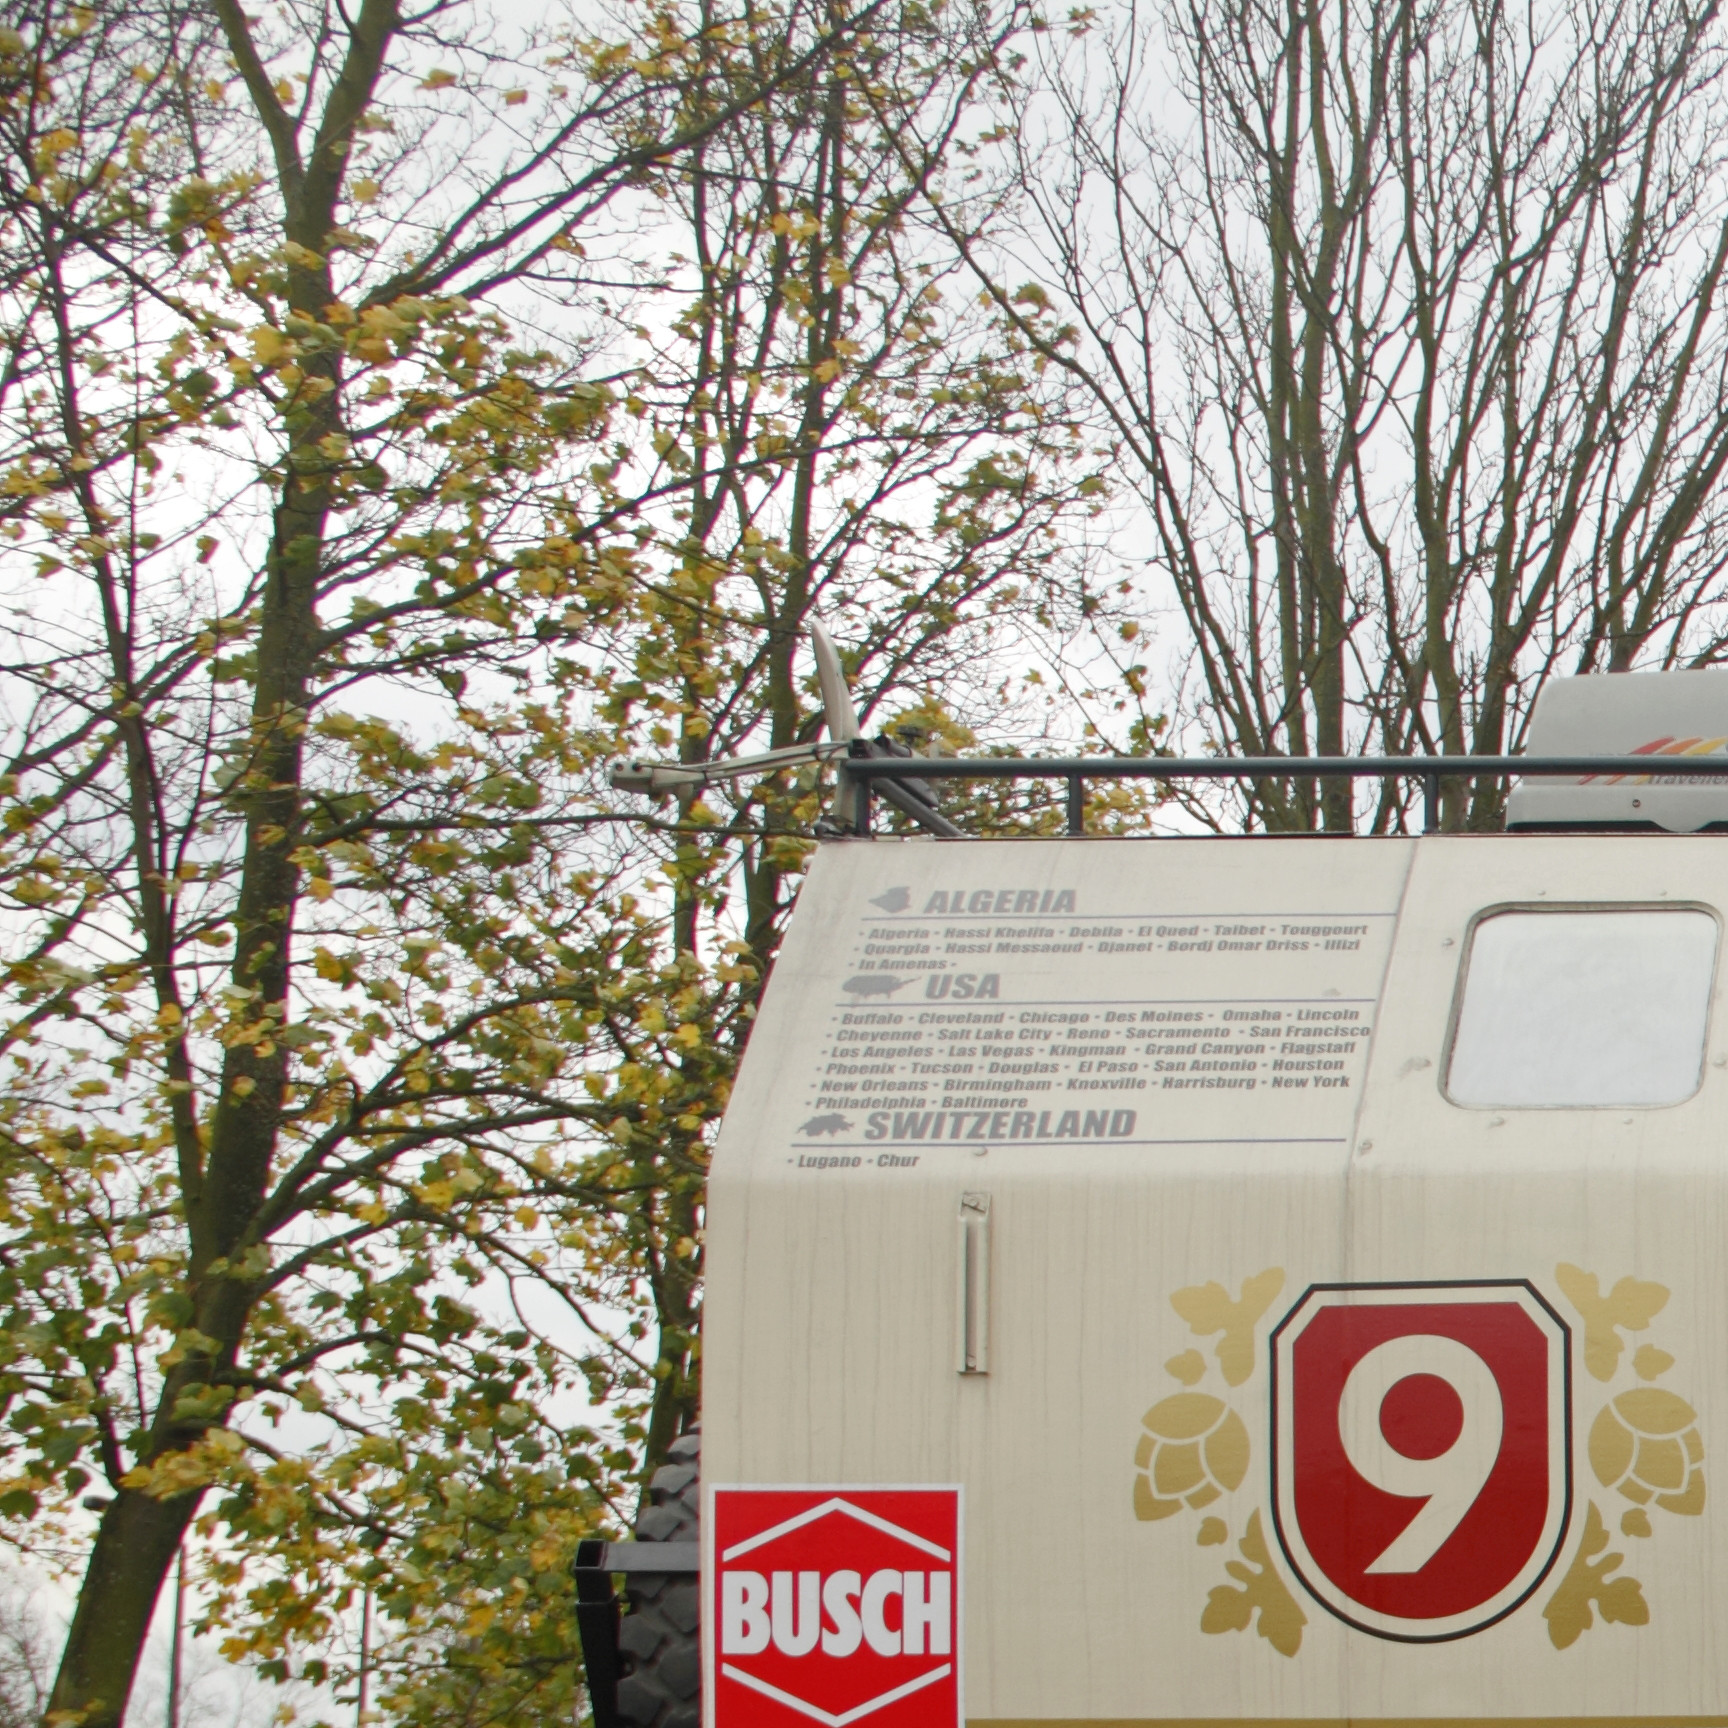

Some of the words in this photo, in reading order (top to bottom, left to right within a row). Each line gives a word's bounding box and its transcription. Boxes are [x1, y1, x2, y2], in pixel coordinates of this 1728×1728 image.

[923, 889, 1077, 914] ALGERIA
[868, 928, 930, 941] Algeria
[944, 927, 990, 939] Hassi
[1213, 924, 1266, 936] Taibet
[1281, 924, 1368, 938] Touggourt
[945, 942, 991, 954] Hassi
[996, 941, 1083, 953] Messaoud
[1167, 940, 1213, 953] Bordj
[1217, 939, 1262, 951] Omar
[1266, 939, 1309, 951] Driss
[858, 960, 876, 970] In
[878, 959, 947, 970] Amenas
[925, 974, 1002, 1000] USA
[841, 1013, 903, 1025] Buffalo
[918, 1012, 1004, 1025] Cleveland
[1019, 1012, 1090, 1025] Chicago
[1105, 1011, 1136, 1023] Des
[1140, 1010, 1204, 1022] Moines
[1222, 1010, 1282, 1021] Omaha
[1297, 1009, 1360, 1021] Lincoln
[836, 1029, 923, 1042] Cheyenne
[937, 1028, 973, 1041] Salt
[975, 1028, 1014, 1040] Lake
[1018, 1028, 1052, 1041] City
[1067, 1028, 1110, 1040] Reno
[1125, 1026, 1231, 1039] Sacramento
[1249, 1026, 1282, 1038] San
[1285, 1025, 1371, 1038] Francisco
[831, 1046, 862, 1058] Los
[863, 1046, 934, 1059] Angeles
[949, 1045, 977, 1057] Las
[981, 1045, 1034, 1058] Vegas
[1049, 1044, 1126, 1057] Kingman
[1145, 1043, 1197, 1055] Grand
[1201, 1043, 1265, 1056] Canyon
[1280, 1042, 1356, 1055] Flagstaff
[825, 1063, 895, 1075] Phoenix
[910, 1062, 974, 1074] Tucson
[988, 1062, 1060, 1075] Douglas
[1078, 1061, 1094, 1073] El
[1096, 1061, 1139, 1073] Paso
[1153, 1060, 1186, 1072] San
[1189, 1060, 1257, 1072] Antonio
[1272, 1059, 1345, 1071] Houston
[820, 1080, 857, 1092] New
[861, 1079, 929, 1092] Orleans
[943, 1078, 1052, 1093] Birmingham
[1067, 1078, 1147, 1090] Knoxville
[1162, 1076, 1257, 1090] Harrisburg
[1271, 1076, 1309, 1088] New
[1313, 1075, 1350, 1088] York
[815, 1097, 926, 1110] Philadelphia
[941, 1096, 1028, 1109] Baltimore
[864, 1109, 1137, 1140] SWITZERLAND
[798, 1154, 862, 1169] Lugano
[877, 1154, 920, 1168] Chur
[1338, 1333, 1503, 1575] 9
[721, 1569, 951, 1658] BUSCH
